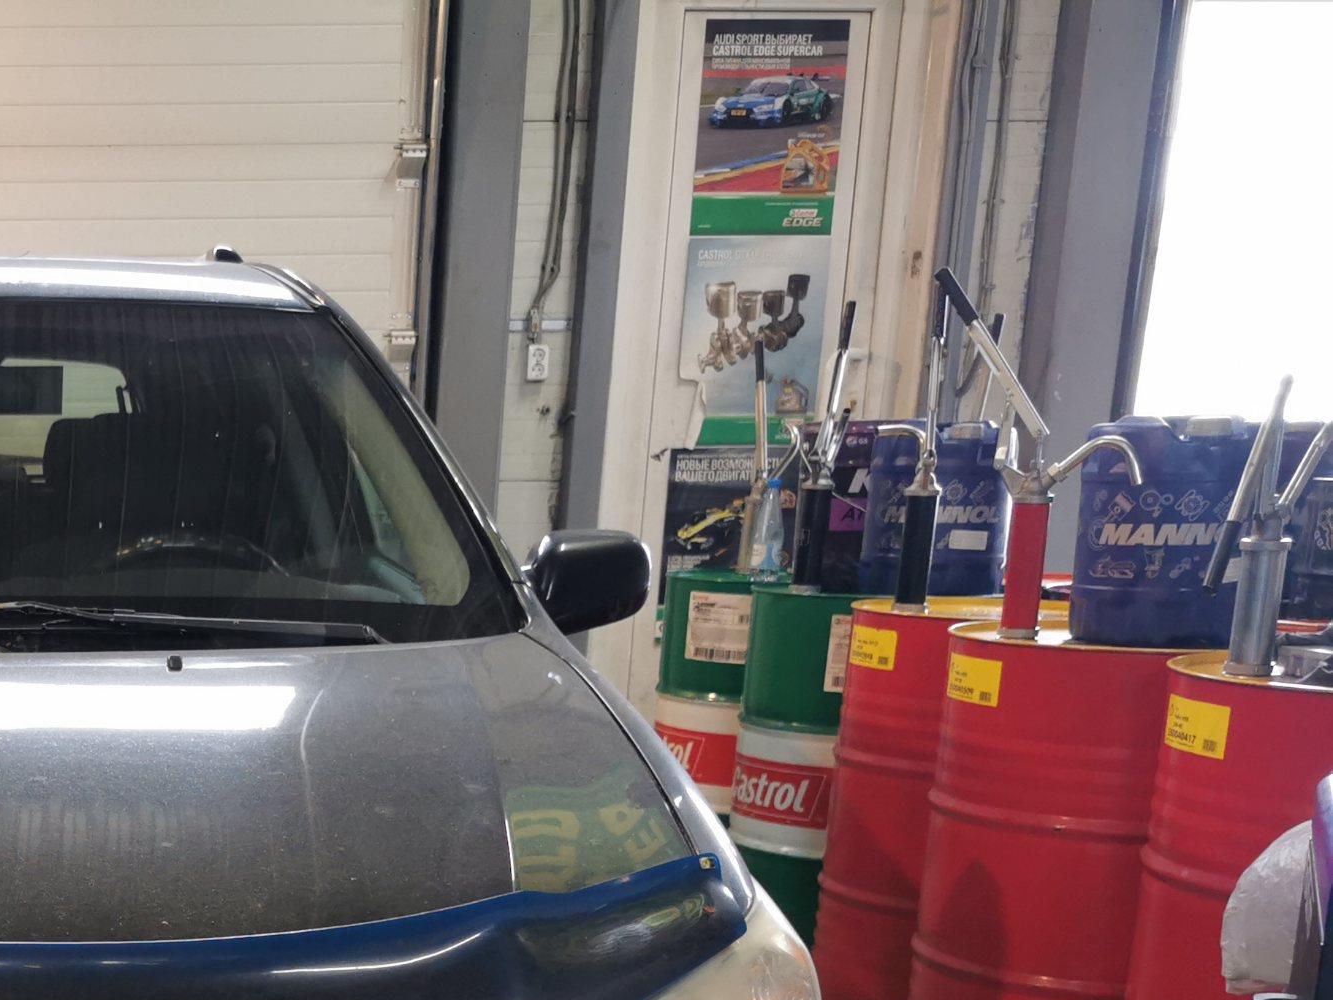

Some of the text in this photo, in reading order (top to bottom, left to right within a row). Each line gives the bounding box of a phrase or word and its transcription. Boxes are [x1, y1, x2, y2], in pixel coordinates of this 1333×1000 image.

[714, 34, 735, 45] AUDI
[736, 34, 764, 45] SPORT
[712, 45, 823, 56] CASTROL EDGE SUPERCAR
[782, 217, 824, 227] EDGE
[677, 459, 710, 471] НОВЫЕ
[715, 470, 751, 483] ДВИГАТ
[884, 505, 999, 524] MNNOL
[1099, 523, 1224, 546] MANN
[732, 766, 809, 813] Castrol
